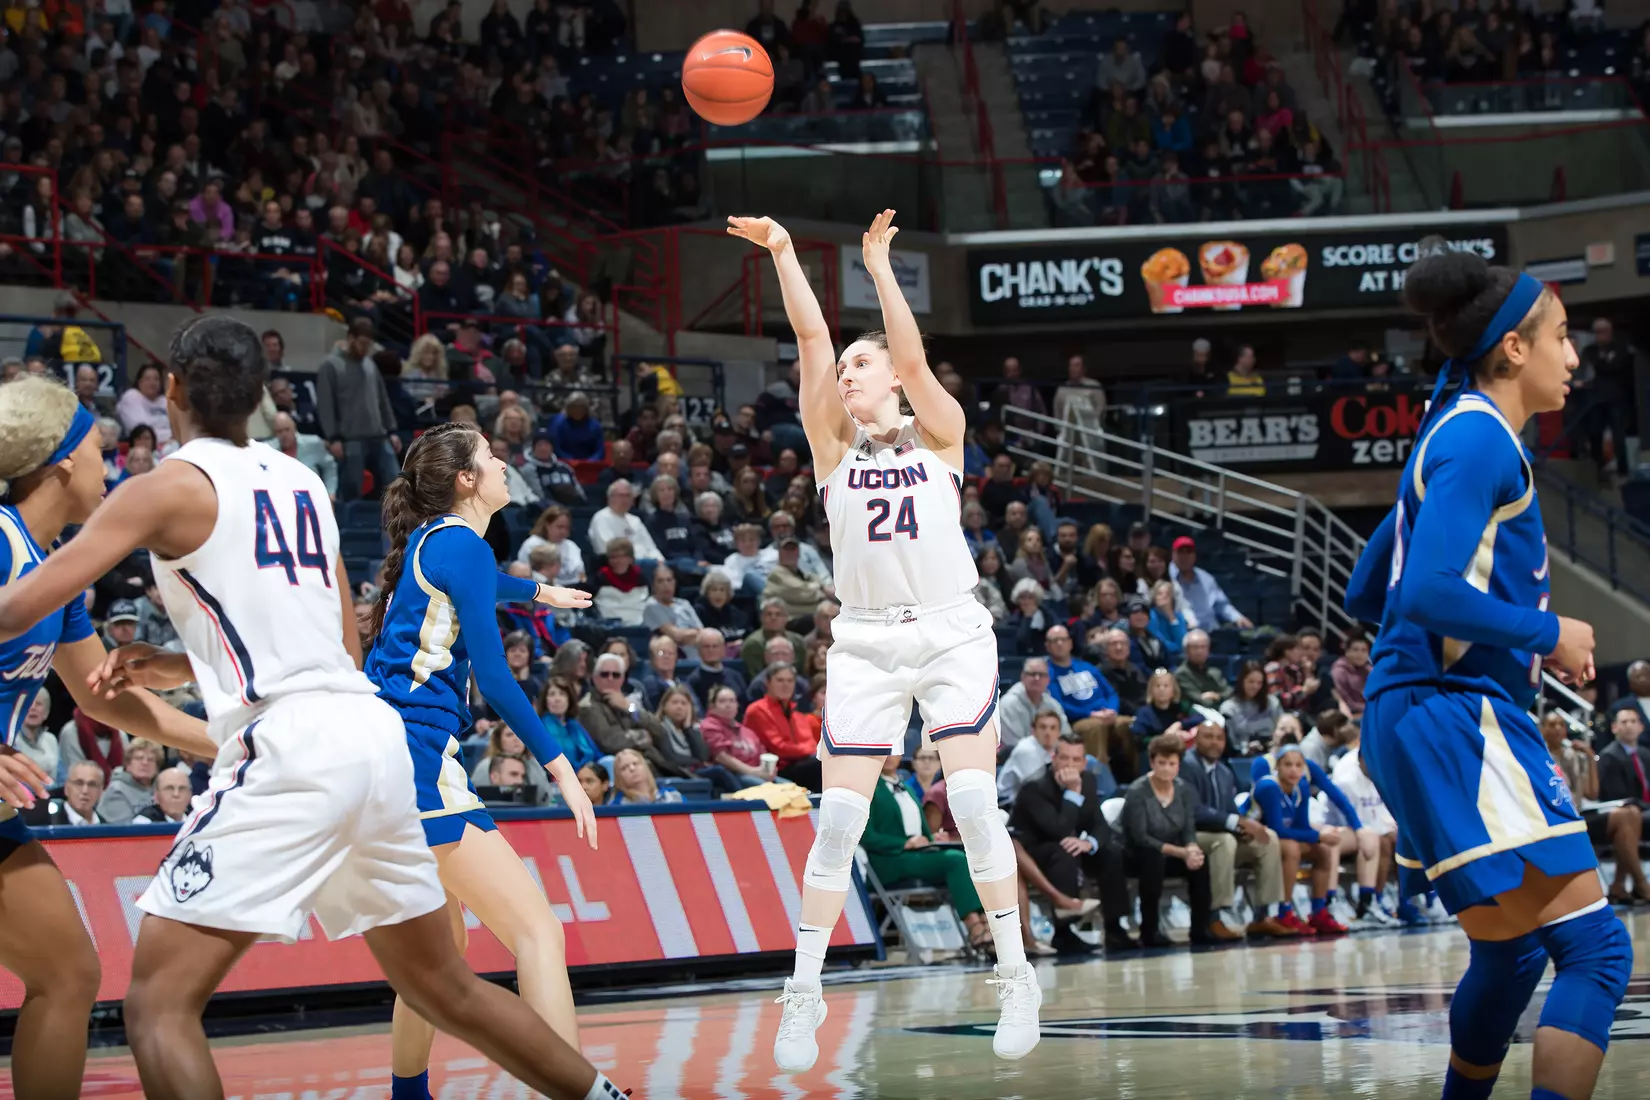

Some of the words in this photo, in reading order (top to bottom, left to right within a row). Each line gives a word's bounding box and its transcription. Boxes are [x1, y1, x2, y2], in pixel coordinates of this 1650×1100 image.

[1322, 242, 1396, 268] SCORE
[980, 256, 1124, 302] CHANK'S
[1359, 270, 1389, 292] AT
[62, 362, 117, 397] 12
[1188, 414, 1320, 448] BEAR'S
[1330, 394, 1425, 440] Cok
[1352, 438, 1416, 464] zer
[866, 495, 919, 542] 24
[252, 488, 332, 589] 44
